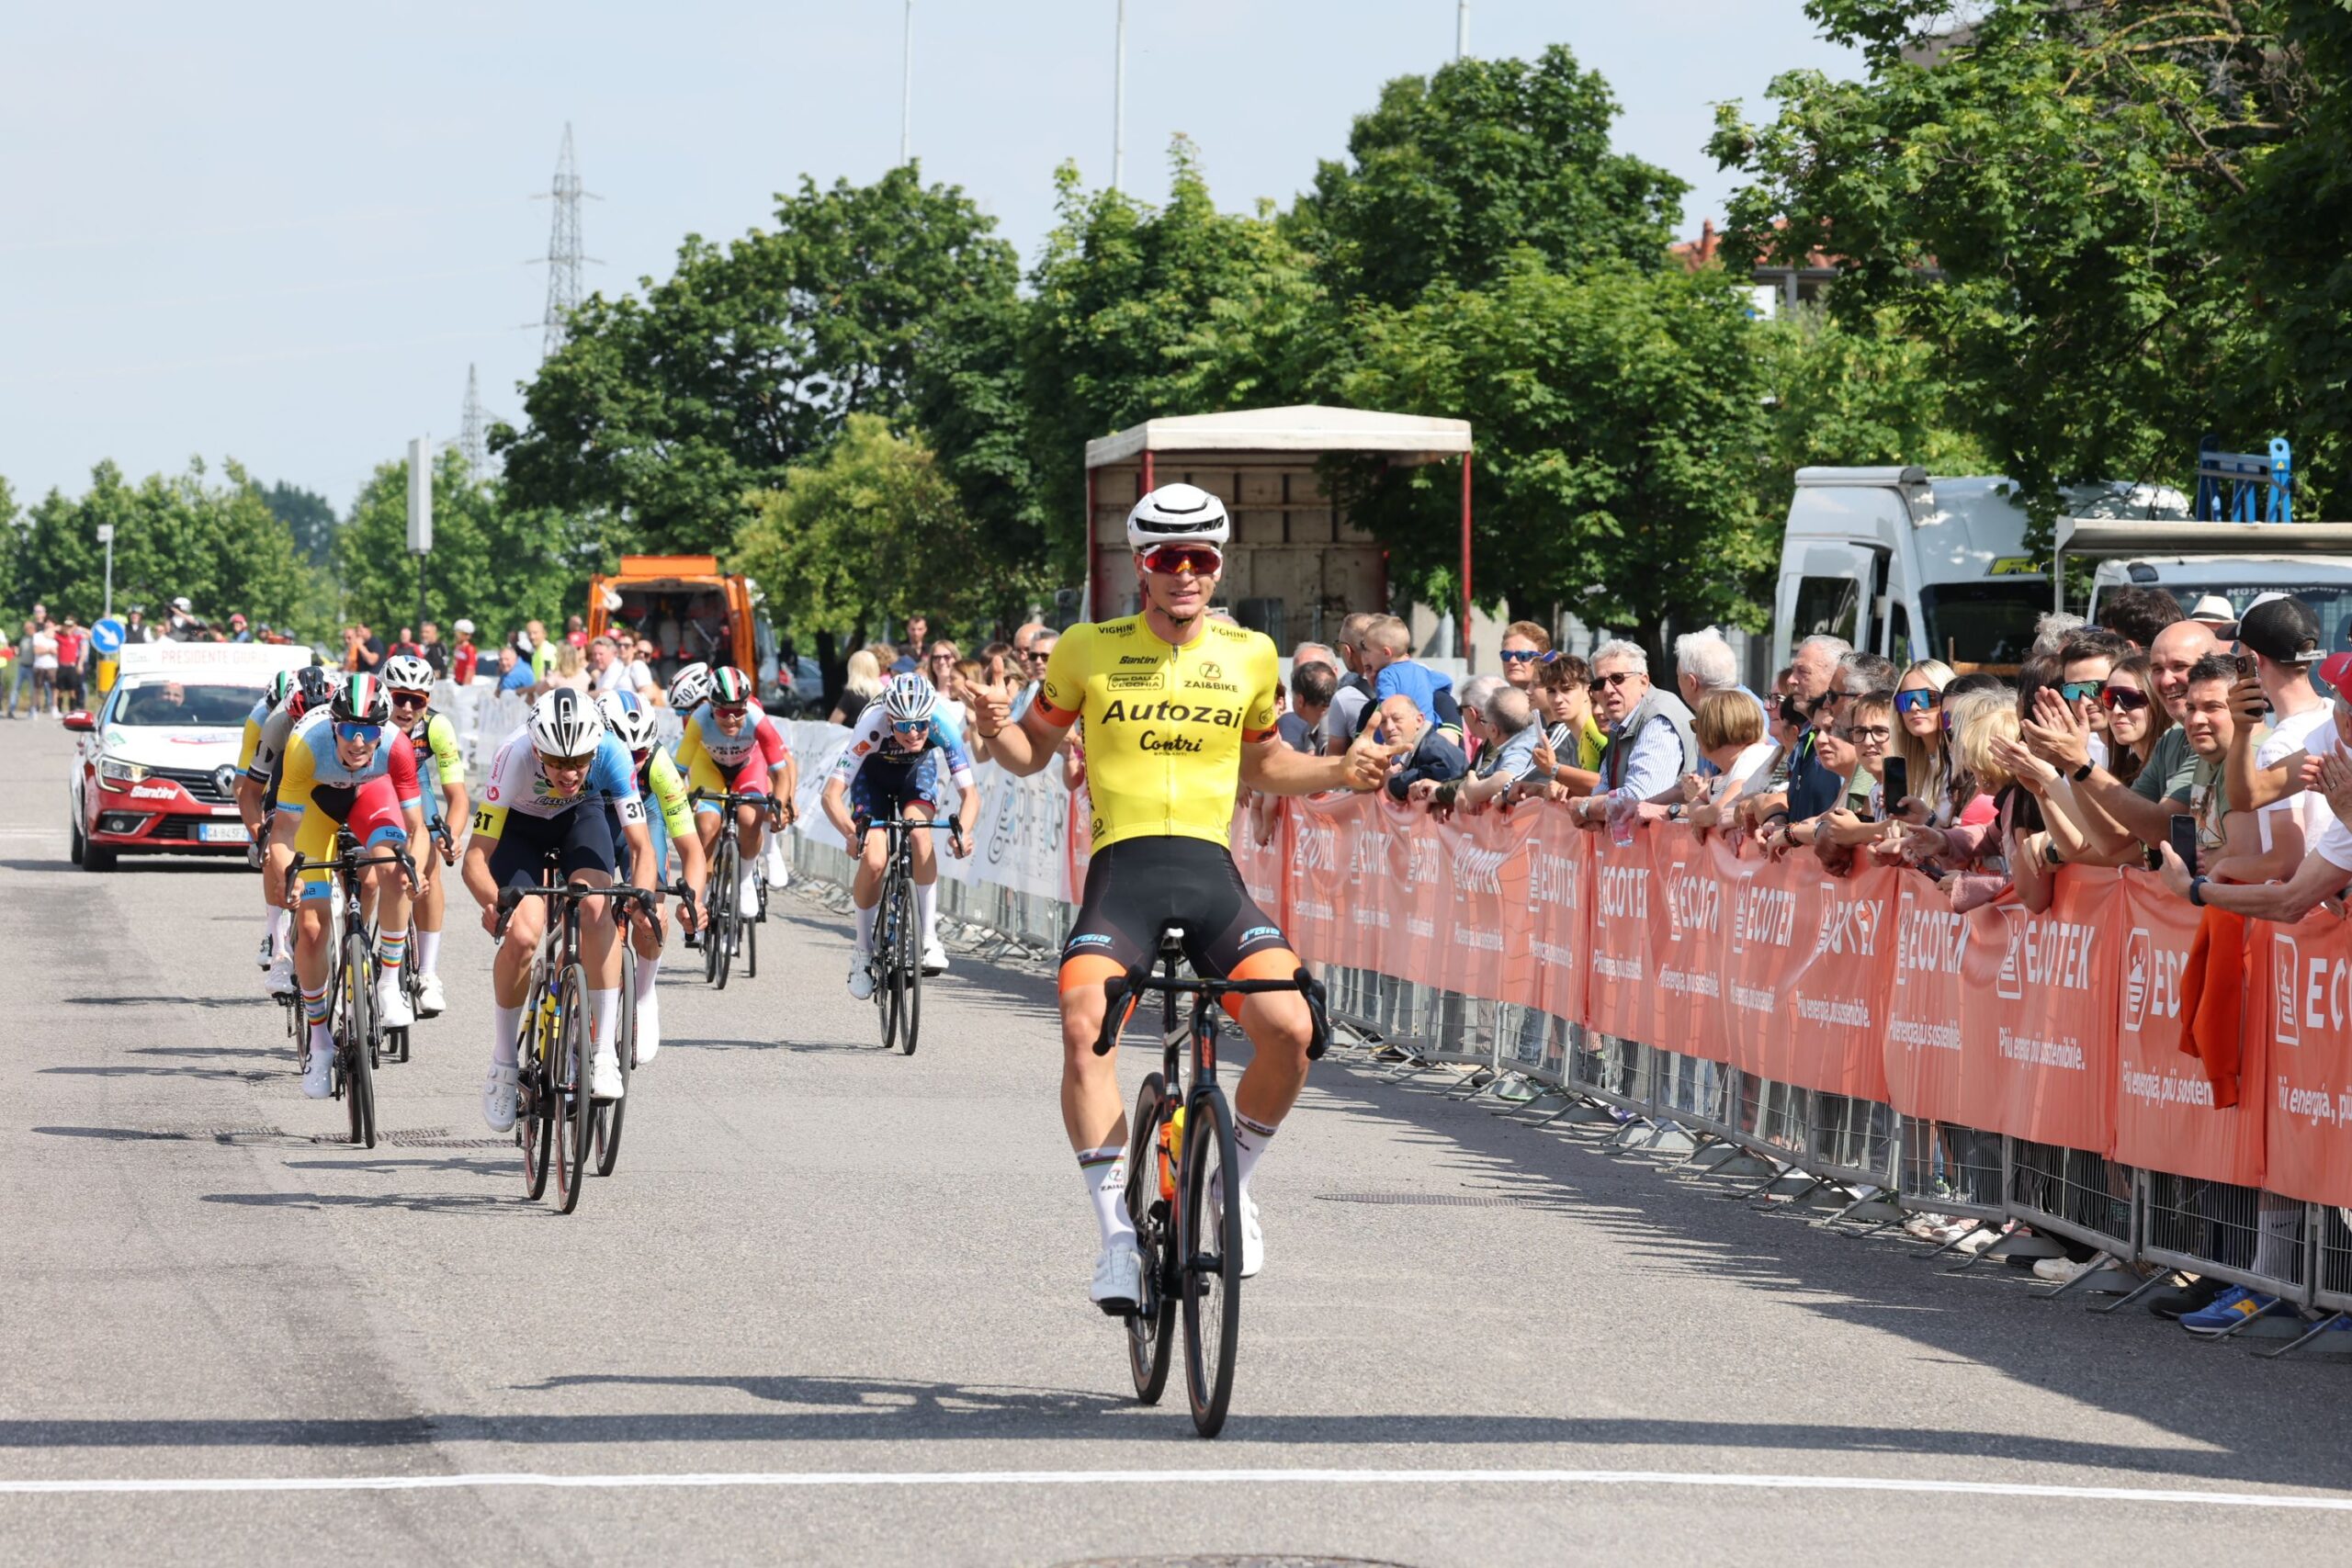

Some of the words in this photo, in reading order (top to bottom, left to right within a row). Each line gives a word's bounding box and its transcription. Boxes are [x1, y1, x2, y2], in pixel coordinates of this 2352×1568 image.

[1098, 623, 1136, 634] VIGHINI
[1210, 624, 1248, 639] VIGHINI
[162, 650, 229, 664] PRESIDENTE
[1118, 655, 1159, 665] Santini
[1183, 681, 1238, 693] ZAI&BIKE
[1101, 699, 1243, 728] Autozai
[1139, 729, 1204, 752] Contri
[130, 785, 181, 800] Santini
[473, 810, 493, 831] 3T
[1541, 853, 1579, 911] ECOTEK
[1746, 886, 1796, 948] ECOTEK
[1907, 909, 1971, 975] ECOTEK
[2024, 920, 2096, 990] ECOTEK
[1998, 1027, 2013, 1058] Più
[2161, 1067, 2177, 1109] più
[2290, 1082, 2336, 1126] energia,
